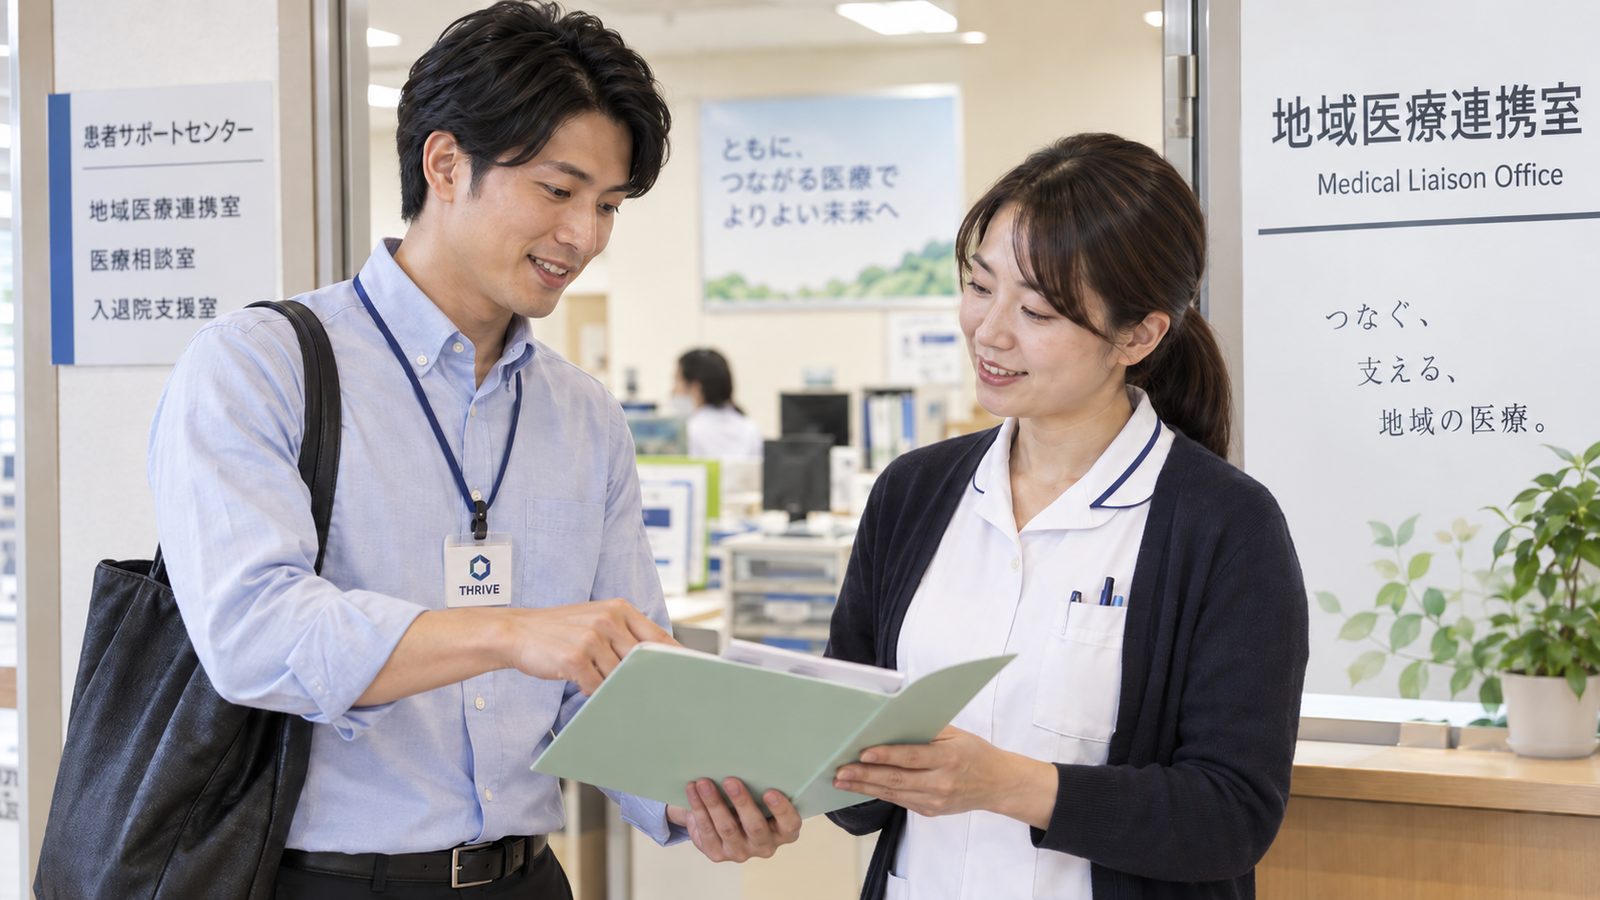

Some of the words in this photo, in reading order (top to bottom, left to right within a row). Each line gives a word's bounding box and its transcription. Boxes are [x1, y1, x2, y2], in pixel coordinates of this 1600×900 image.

[1271, 81, 1583, 149] 地域医療連携室
[83, 119, 254, 149] 患者サポートセンター
[722, 137, 802, 162] ともに、
[721, 165, 898, 194] つながる医療で
[1318, 168, 1400, 196] Medical
[1408, 166, 1486, 192] Liaison
[1494, 162, 1564, 188] Office
[89, 195, 241, 222] 地域医療連携室
[723, 199, 900, 228] よりよい未来へ
[90, 247, 195, 272] 医療相談室
[91, 296, 218, 321] 入退院支援室
[1325, 300, 1428, 331] つなぐ、
[1358, 355, 1455, 386] 支える、
[1379, 402, 1545, 437] 地域の医療。
[459, 584, 499, 595] THRIVE
